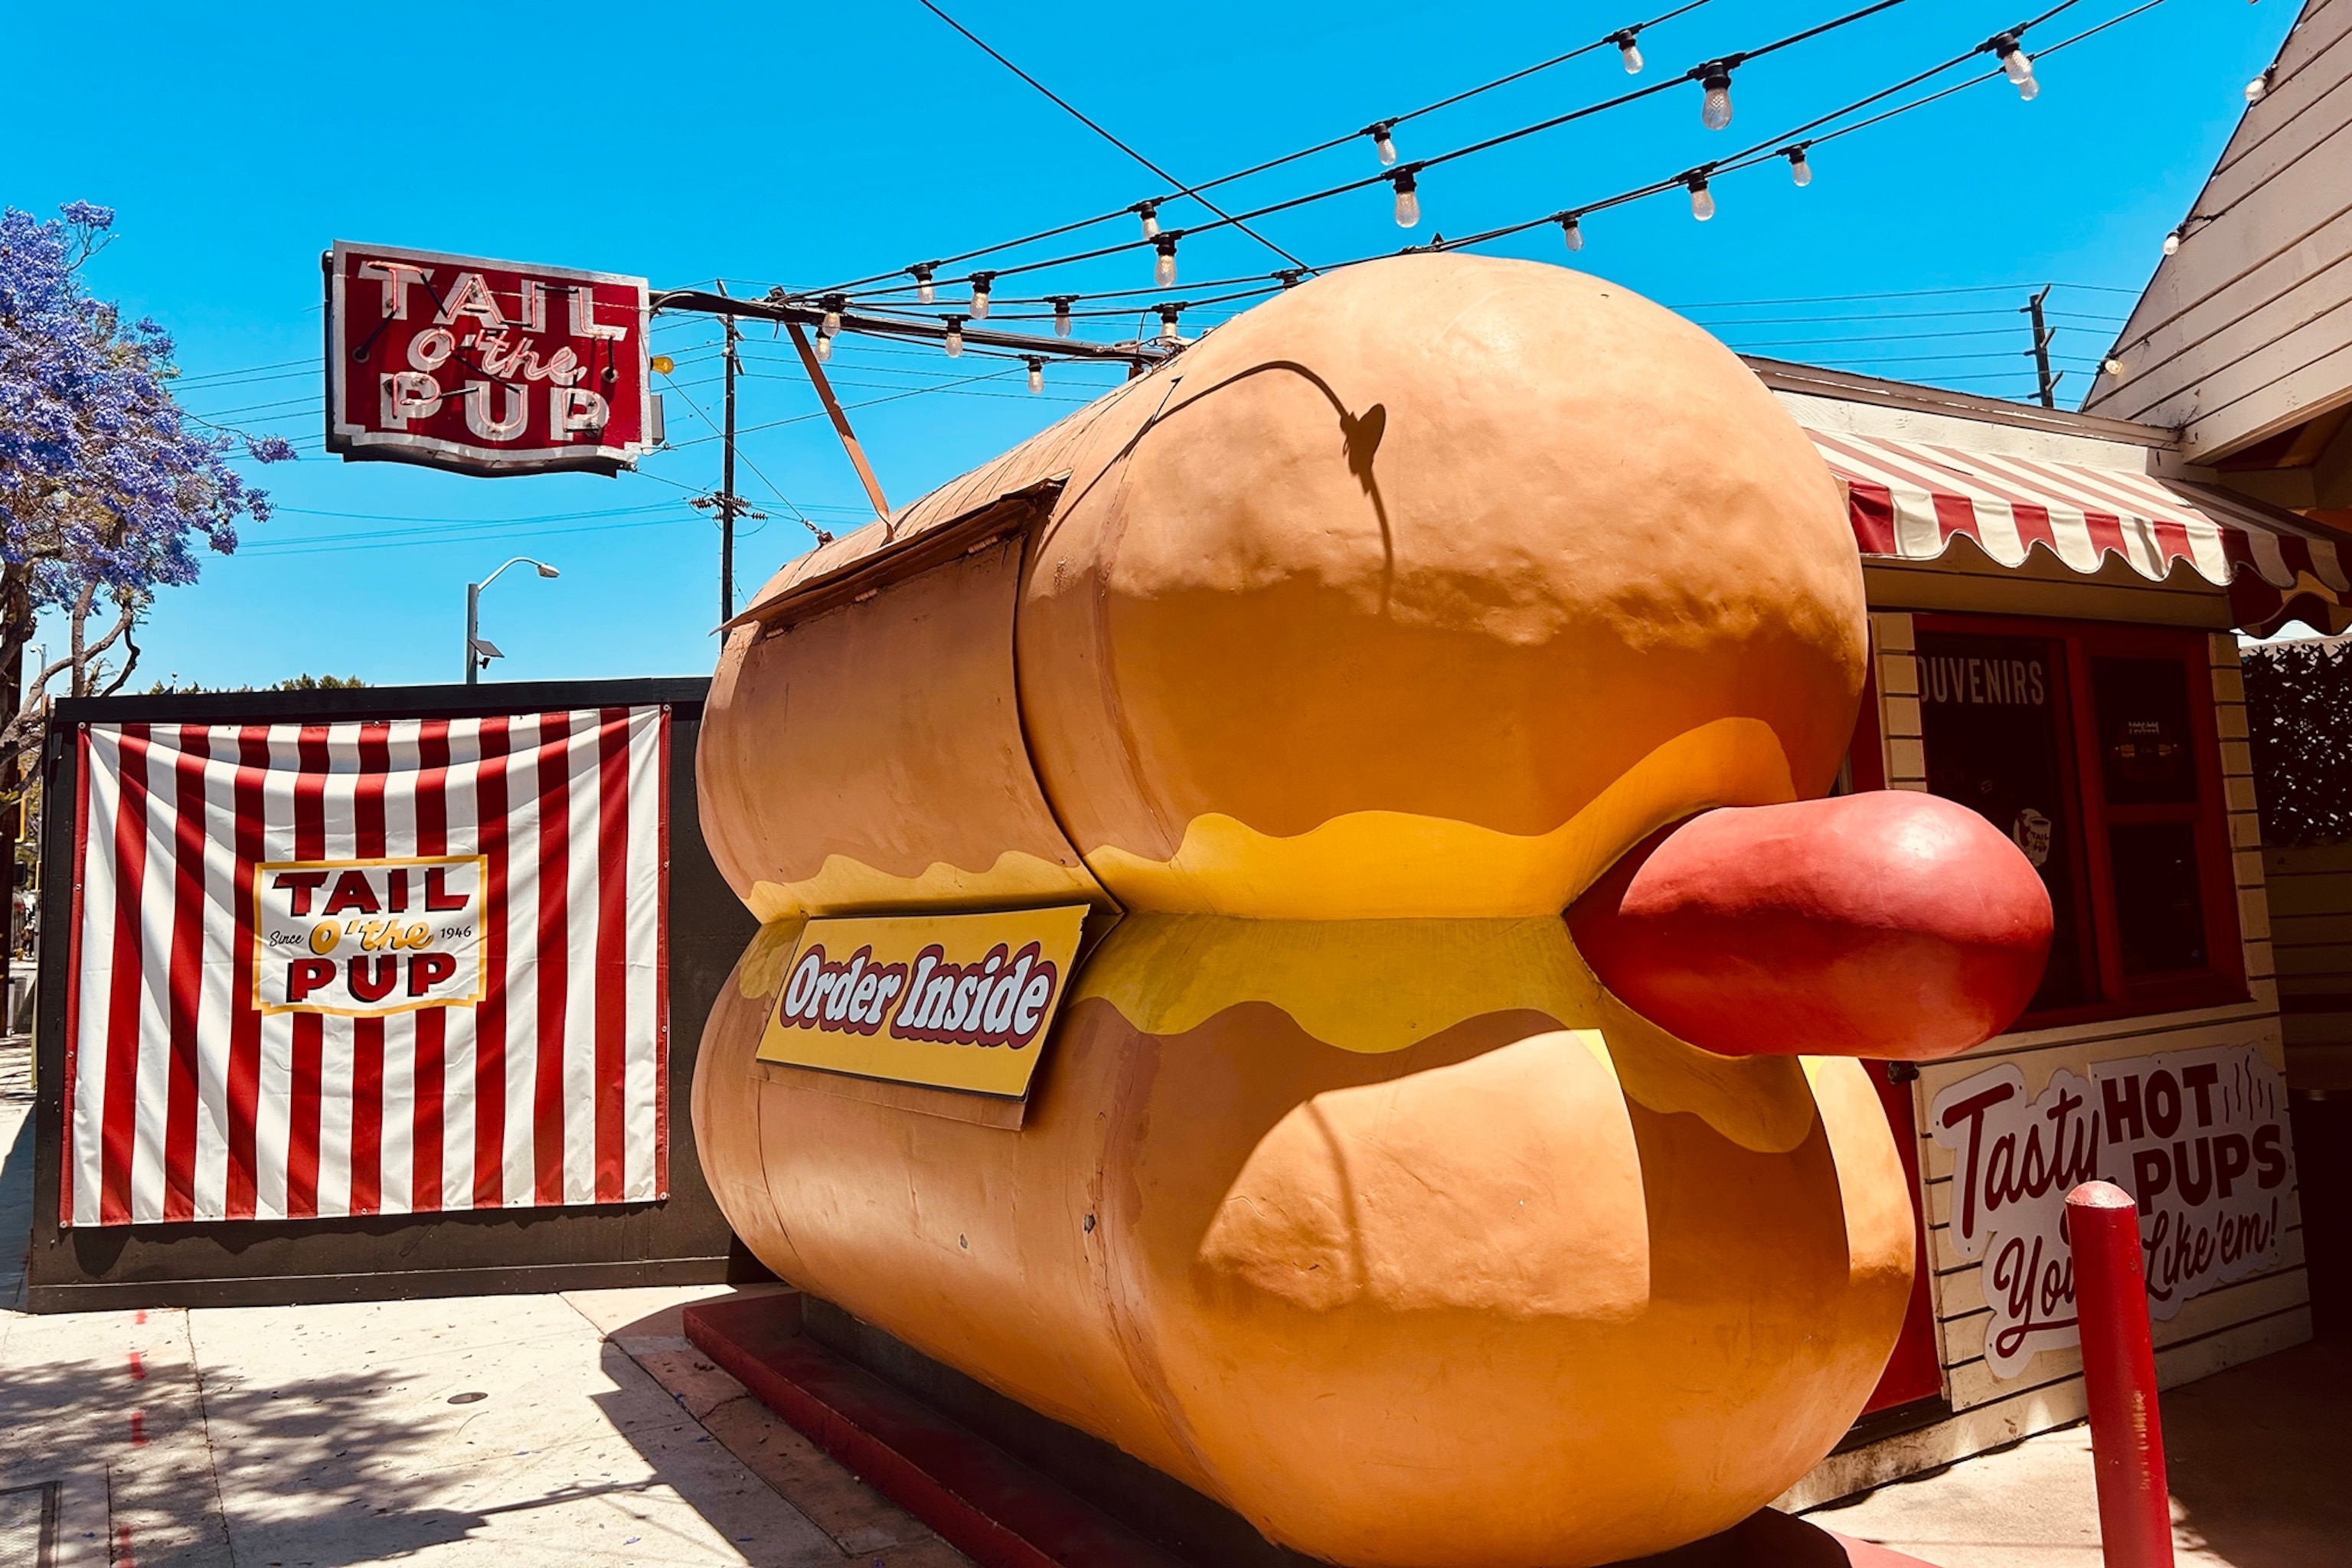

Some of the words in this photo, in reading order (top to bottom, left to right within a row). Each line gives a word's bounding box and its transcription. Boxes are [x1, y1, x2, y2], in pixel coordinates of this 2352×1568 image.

[358, 260, 628, 341] TAIL
[380, 371, 610, 442] PUP
[1917, 656, 2045, 706] OUVENIRS
[272, 867, 470, 916] TAIL
[269, 931, 305, 947] Since
[440, 926, 472, 939] 1946
[286, 952, 456, 1003] PUP
[782, 949, 906, 1031] Order
[892, 947, 1054, 1044] Inside
[1942, 1082, 2109, 1242] Tasty
[2101, 1063, 2218, 1145] HOT
[2133, 1125, 2286, 1216] PUPS
